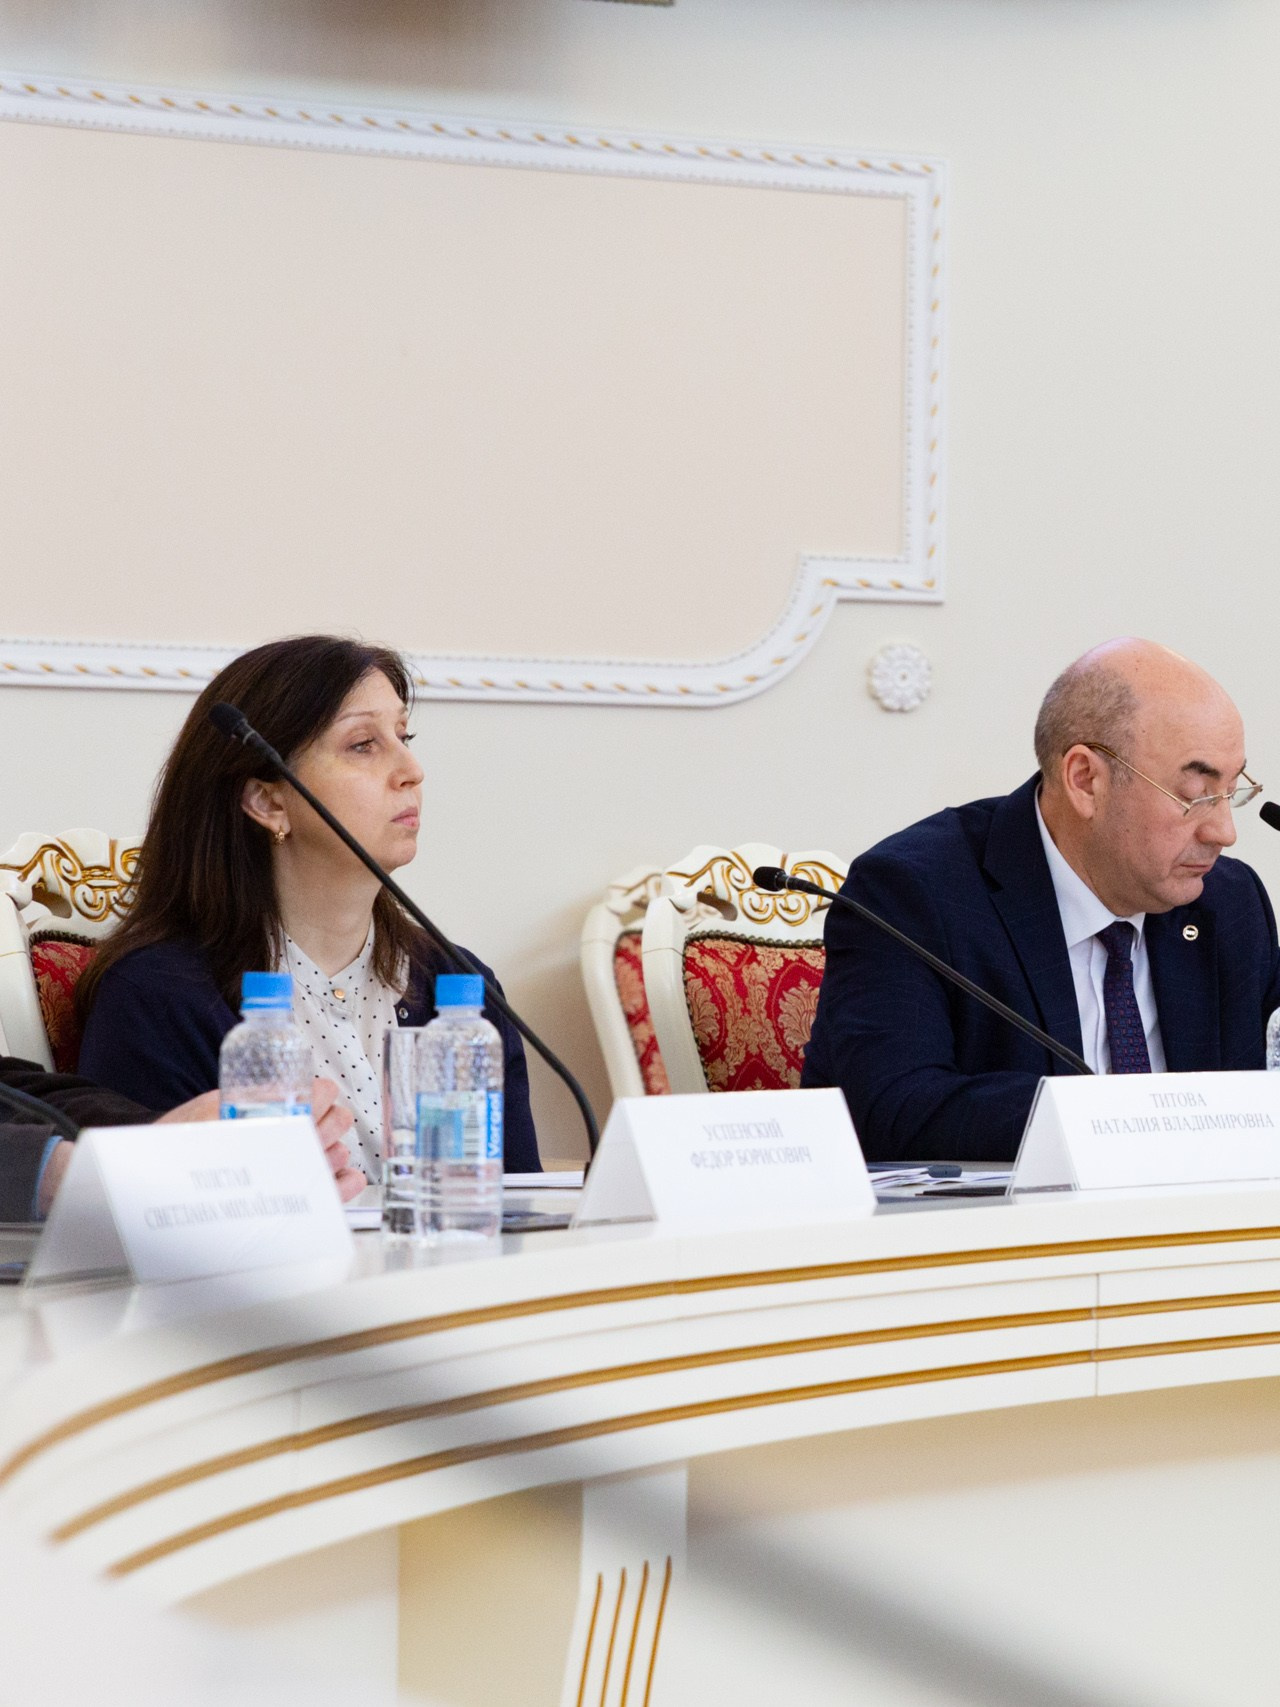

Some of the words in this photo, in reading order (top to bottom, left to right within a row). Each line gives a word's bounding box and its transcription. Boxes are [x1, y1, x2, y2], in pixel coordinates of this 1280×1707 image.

[1149, 1092, 1208, 1109] ТИТОВА
[702, 1118, 784, 1141] УСПЕНСКИЙ
[1091, 1116, 1161, 1135] НАТАЛИЯ
[1162, 1113, 1275, 1132] ВЛАДИМИРОВНА
[735, 1145, 813, 1166] БОРИСОВИЧ
